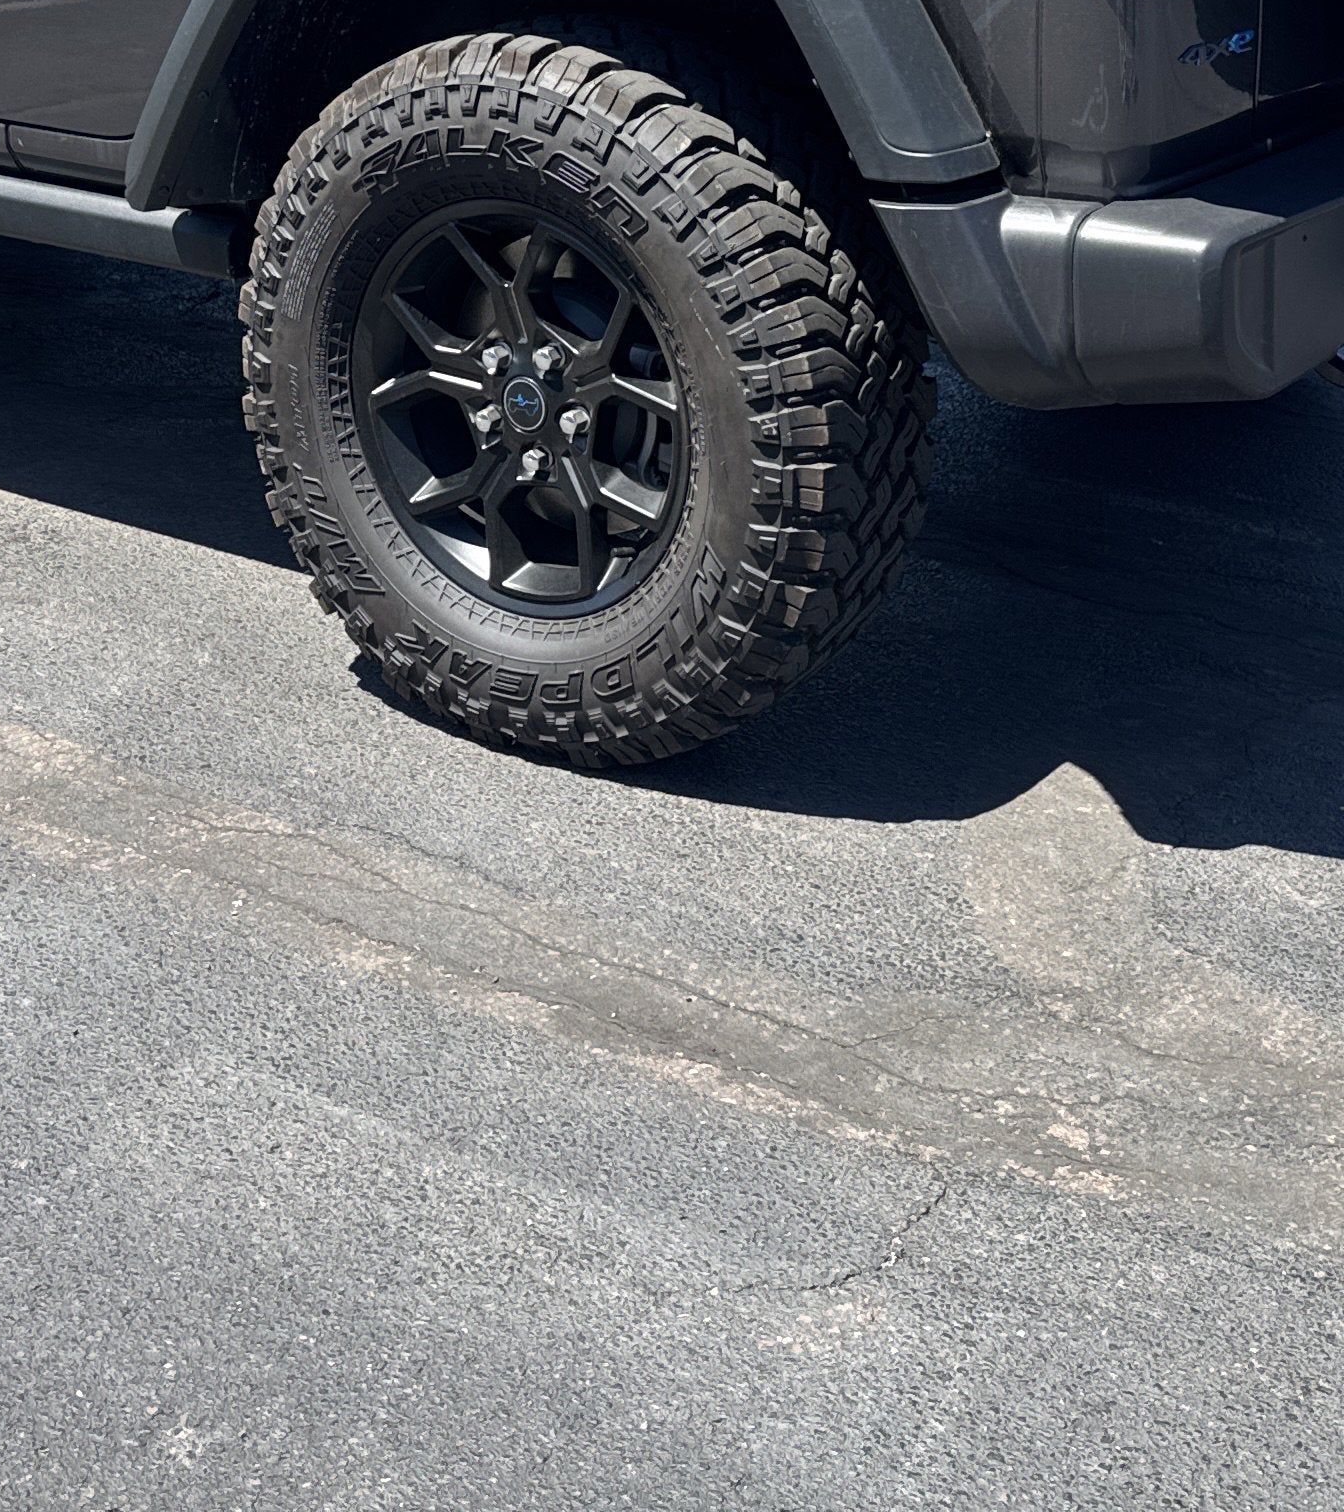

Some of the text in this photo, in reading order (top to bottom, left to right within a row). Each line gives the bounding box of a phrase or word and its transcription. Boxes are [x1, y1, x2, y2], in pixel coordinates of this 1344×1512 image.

[1177, 29, 1255, 66] 4xe
[351, 125, 649, 237] FALKEN
[393, 540, 728, 706] WILDPEAK
